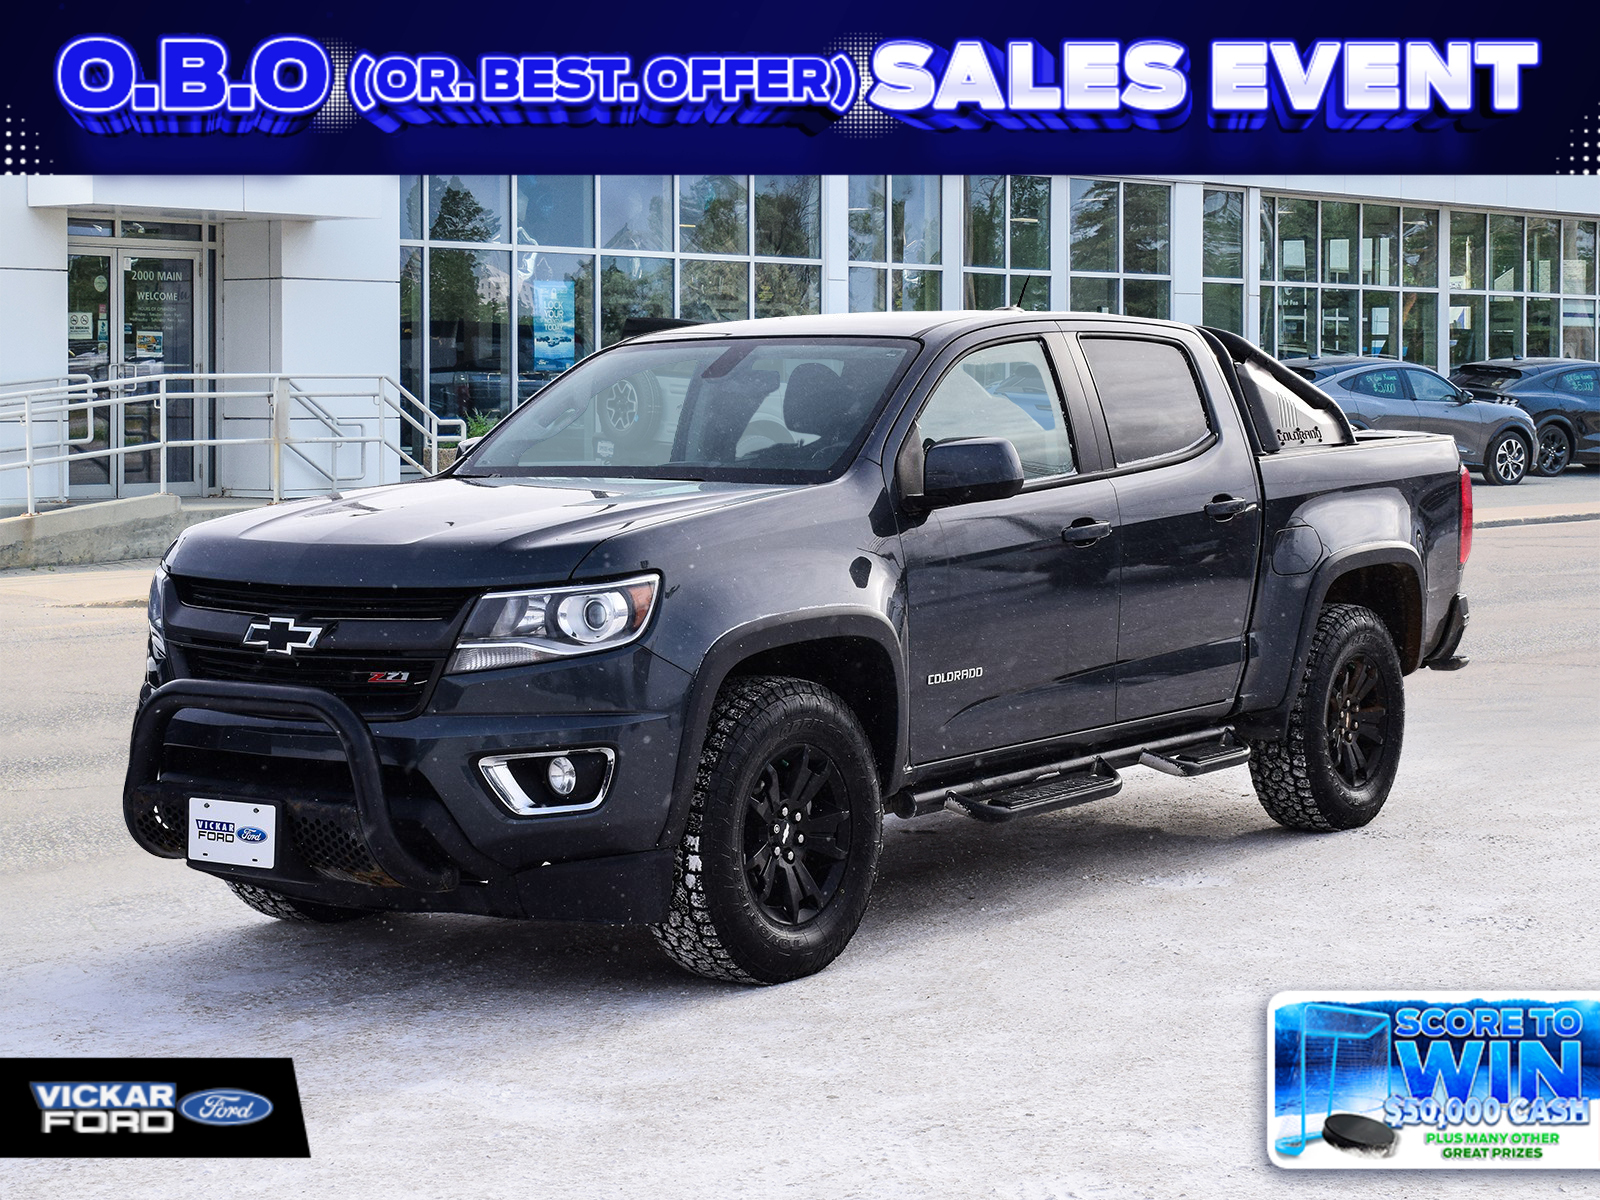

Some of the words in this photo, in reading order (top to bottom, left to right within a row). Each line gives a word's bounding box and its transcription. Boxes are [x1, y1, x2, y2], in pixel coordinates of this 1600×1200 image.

[131, 270, 155, 281] 2000
[157, 271, 183, 282] MAIN
[137, 291, 178, 301] WELCOME
[543, 300, 564, 310] LOCK
[543, 309, 564, 319] YOUR
[368, 671, 410, 683] Z71
[927, 667, 983, 685] COLORADO
[197, 820, 235, 832] VICKAR
[198, 830, 235, 843] FORD
[241, 828, 262, 841] Ford
